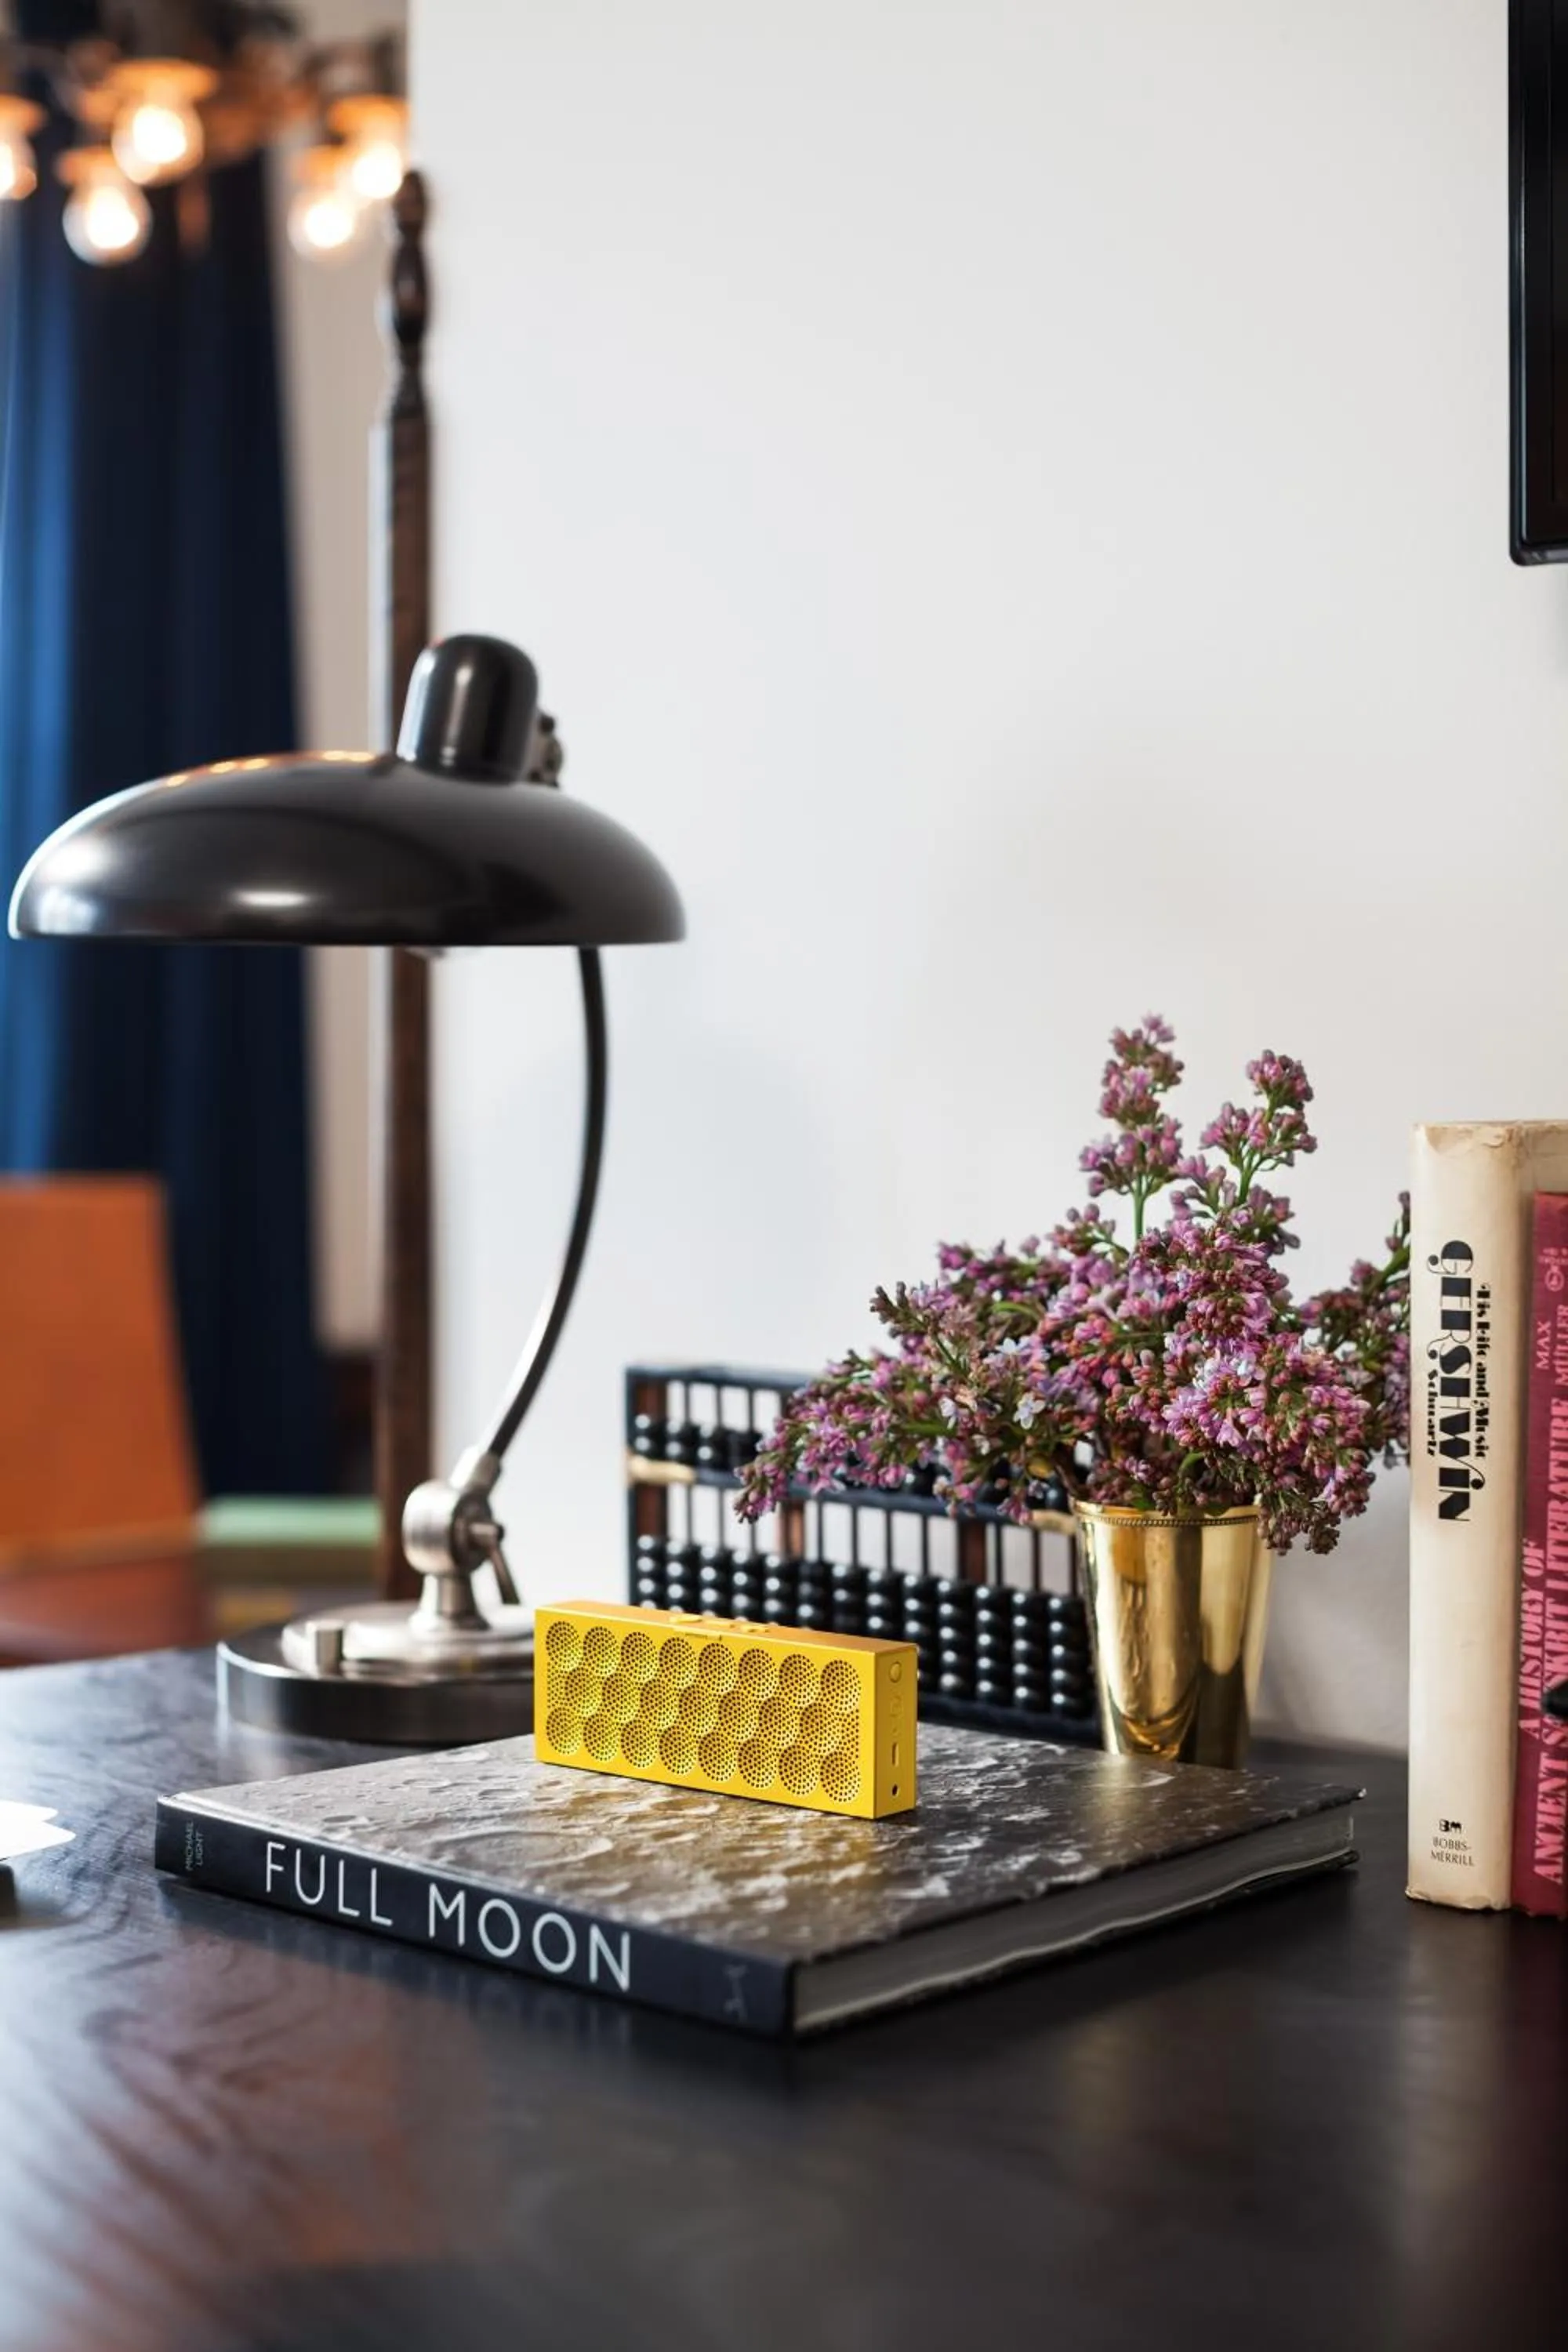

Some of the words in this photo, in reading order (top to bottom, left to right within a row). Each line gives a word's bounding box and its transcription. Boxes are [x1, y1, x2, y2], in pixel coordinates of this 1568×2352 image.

[1426, 1240, 1485, 1522] GERSHWIN
[1475, 1362, 1490, 1397] and
[1535, 1320, 1552, 1370] MAX
[1523, 1538, 1544, 1577] OF
[1519, 1582, 1544, 1711] HISTORY
[1541, 1598, 1568, 1748] SSKRIT
[1519, 1719, 1541, 1740] A
[1431, 1849, 1475, 1866] MERRILL
[1534, 1751, 1568, 1885] ANCIENT
[265, 1841, 394, 1928] FULL
[428, 1882, 631, 1992] MOON
